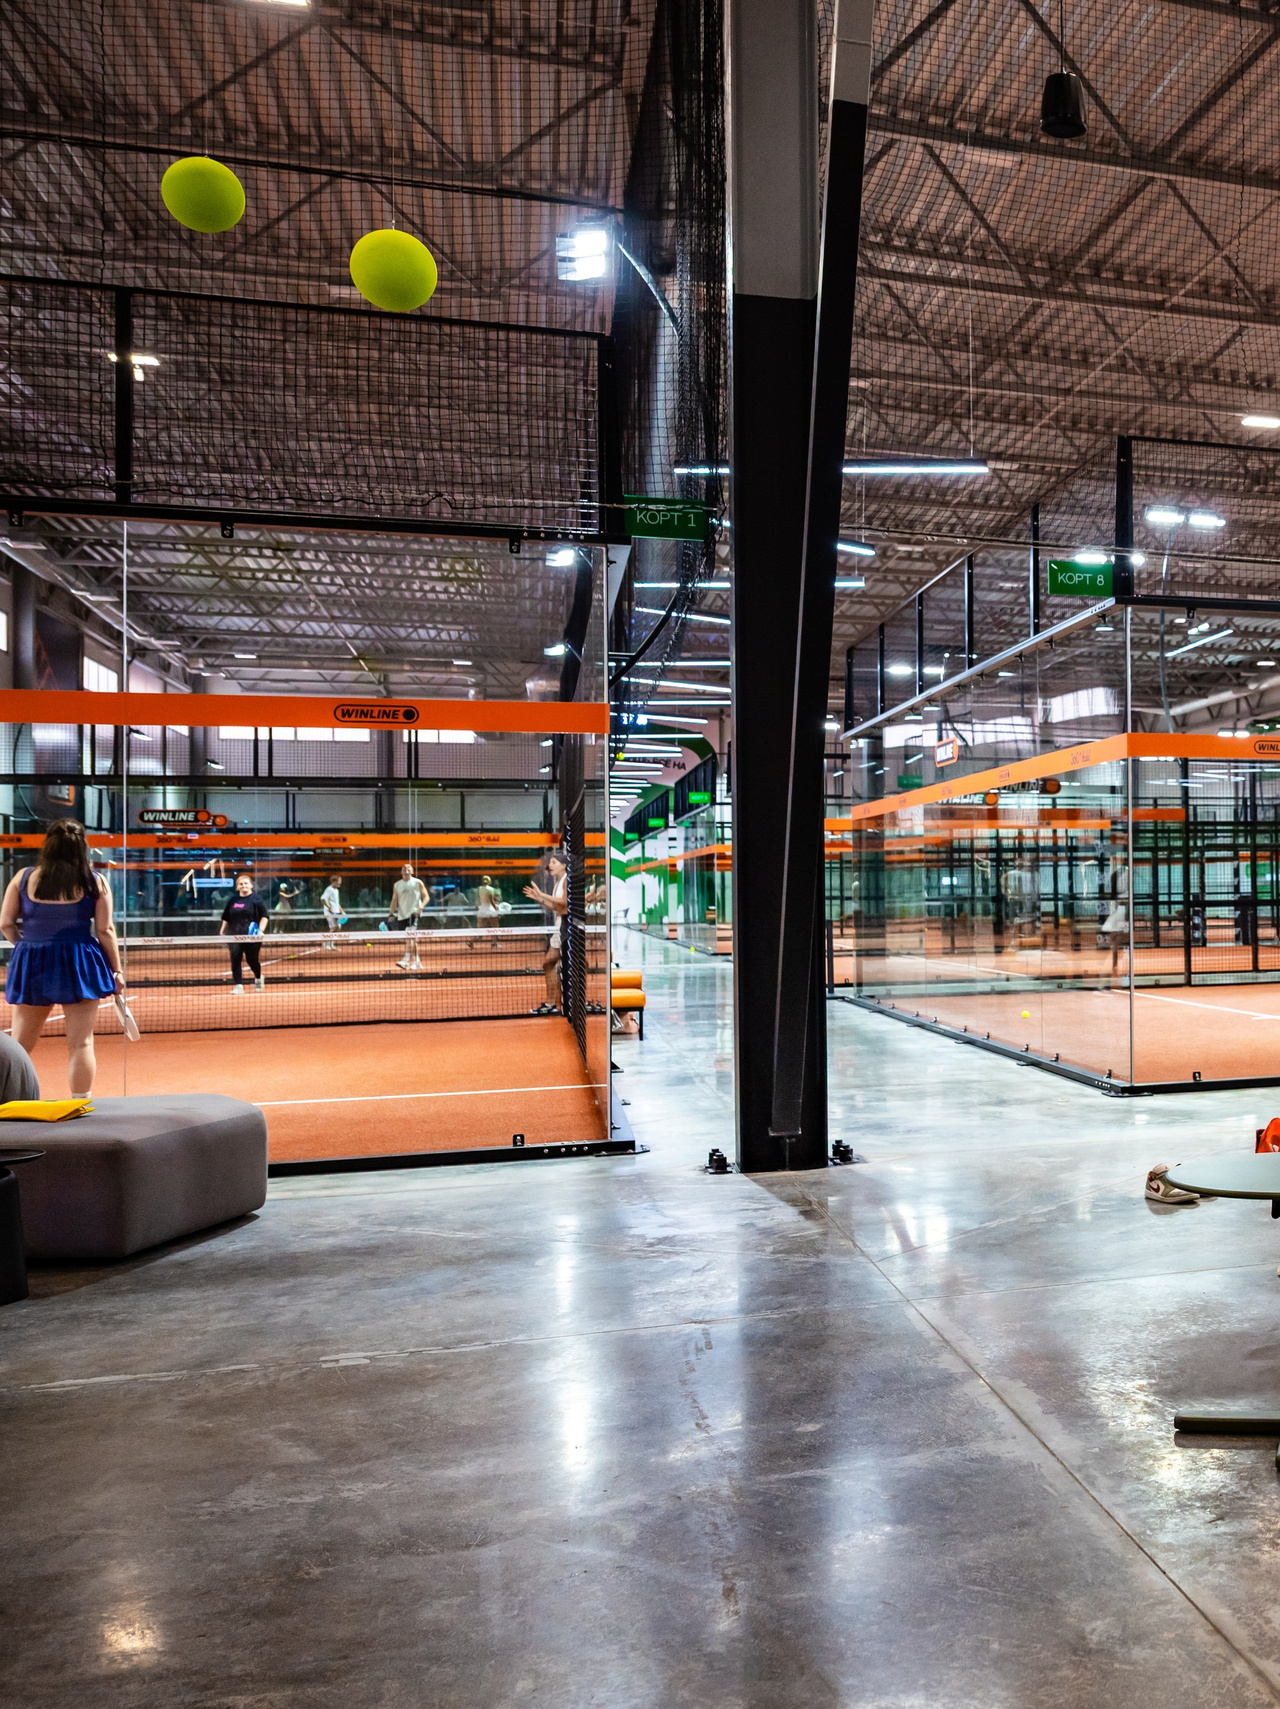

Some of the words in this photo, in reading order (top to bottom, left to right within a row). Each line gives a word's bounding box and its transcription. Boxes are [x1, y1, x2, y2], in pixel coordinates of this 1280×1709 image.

[636, 509, 683, 526] КОРТ
[687, 513, 697, 527] 1
[1057, 572, 1093, 585] КОРТ
[1096, 574, 1105, 586] 8
[341, 708, 400, 720] WINLINE
[143, 812, 196, 821] WINLINE
